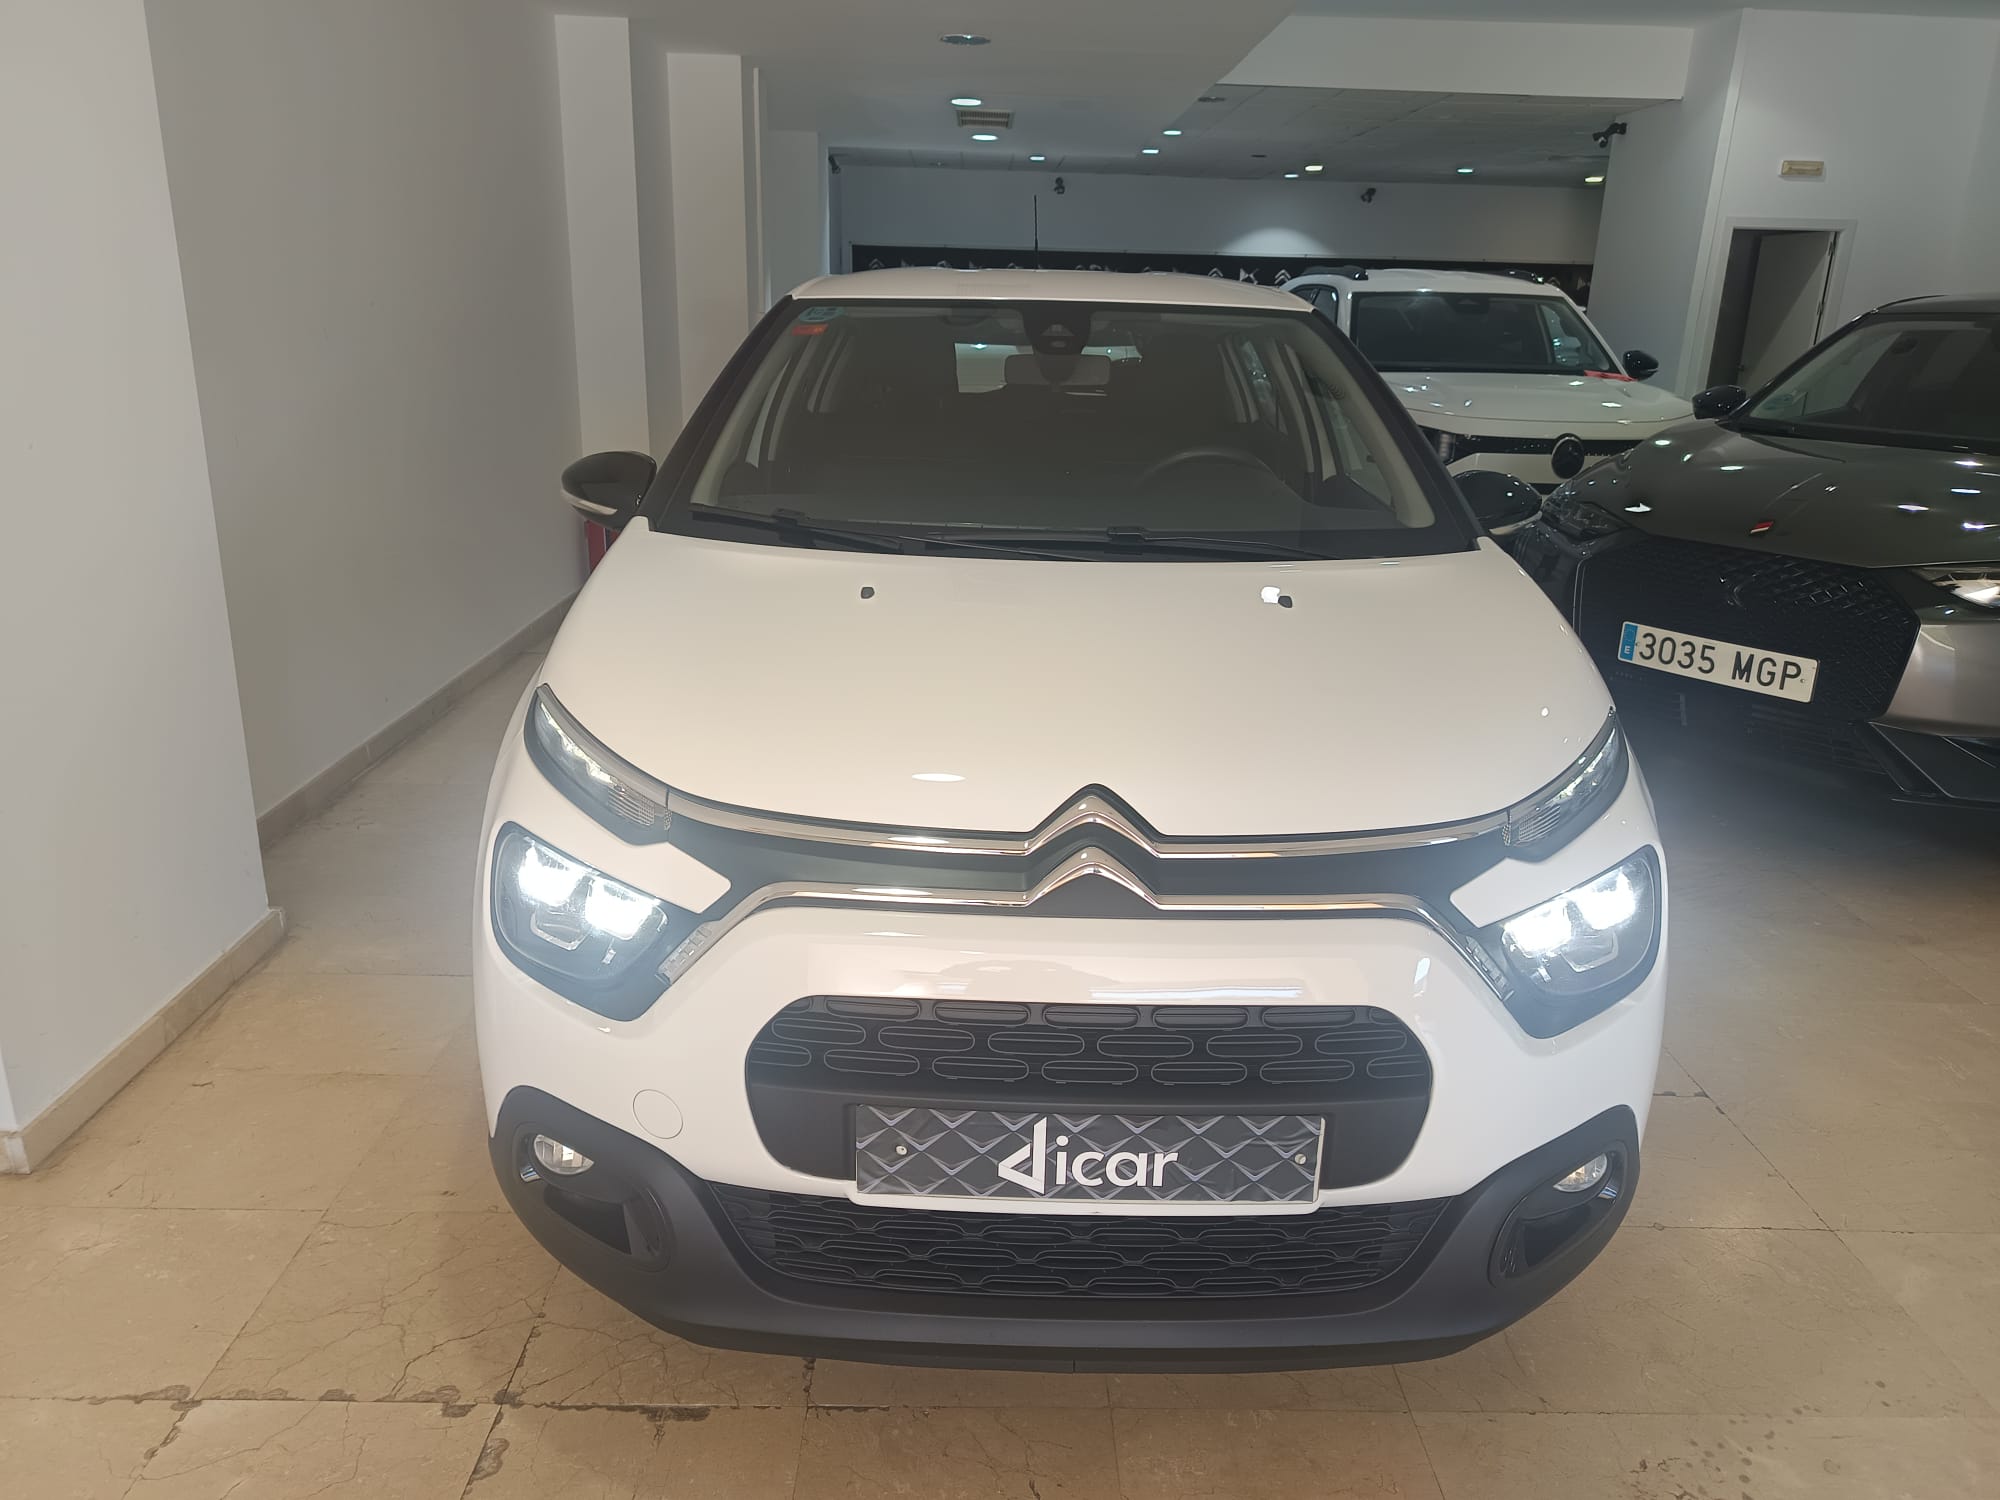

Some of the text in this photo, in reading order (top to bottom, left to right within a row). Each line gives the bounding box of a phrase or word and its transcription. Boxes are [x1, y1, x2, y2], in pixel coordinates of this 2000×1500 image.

[1624, 645, 1631, 655] E
[1639, 632, 1802, 691] 3035 MGP
